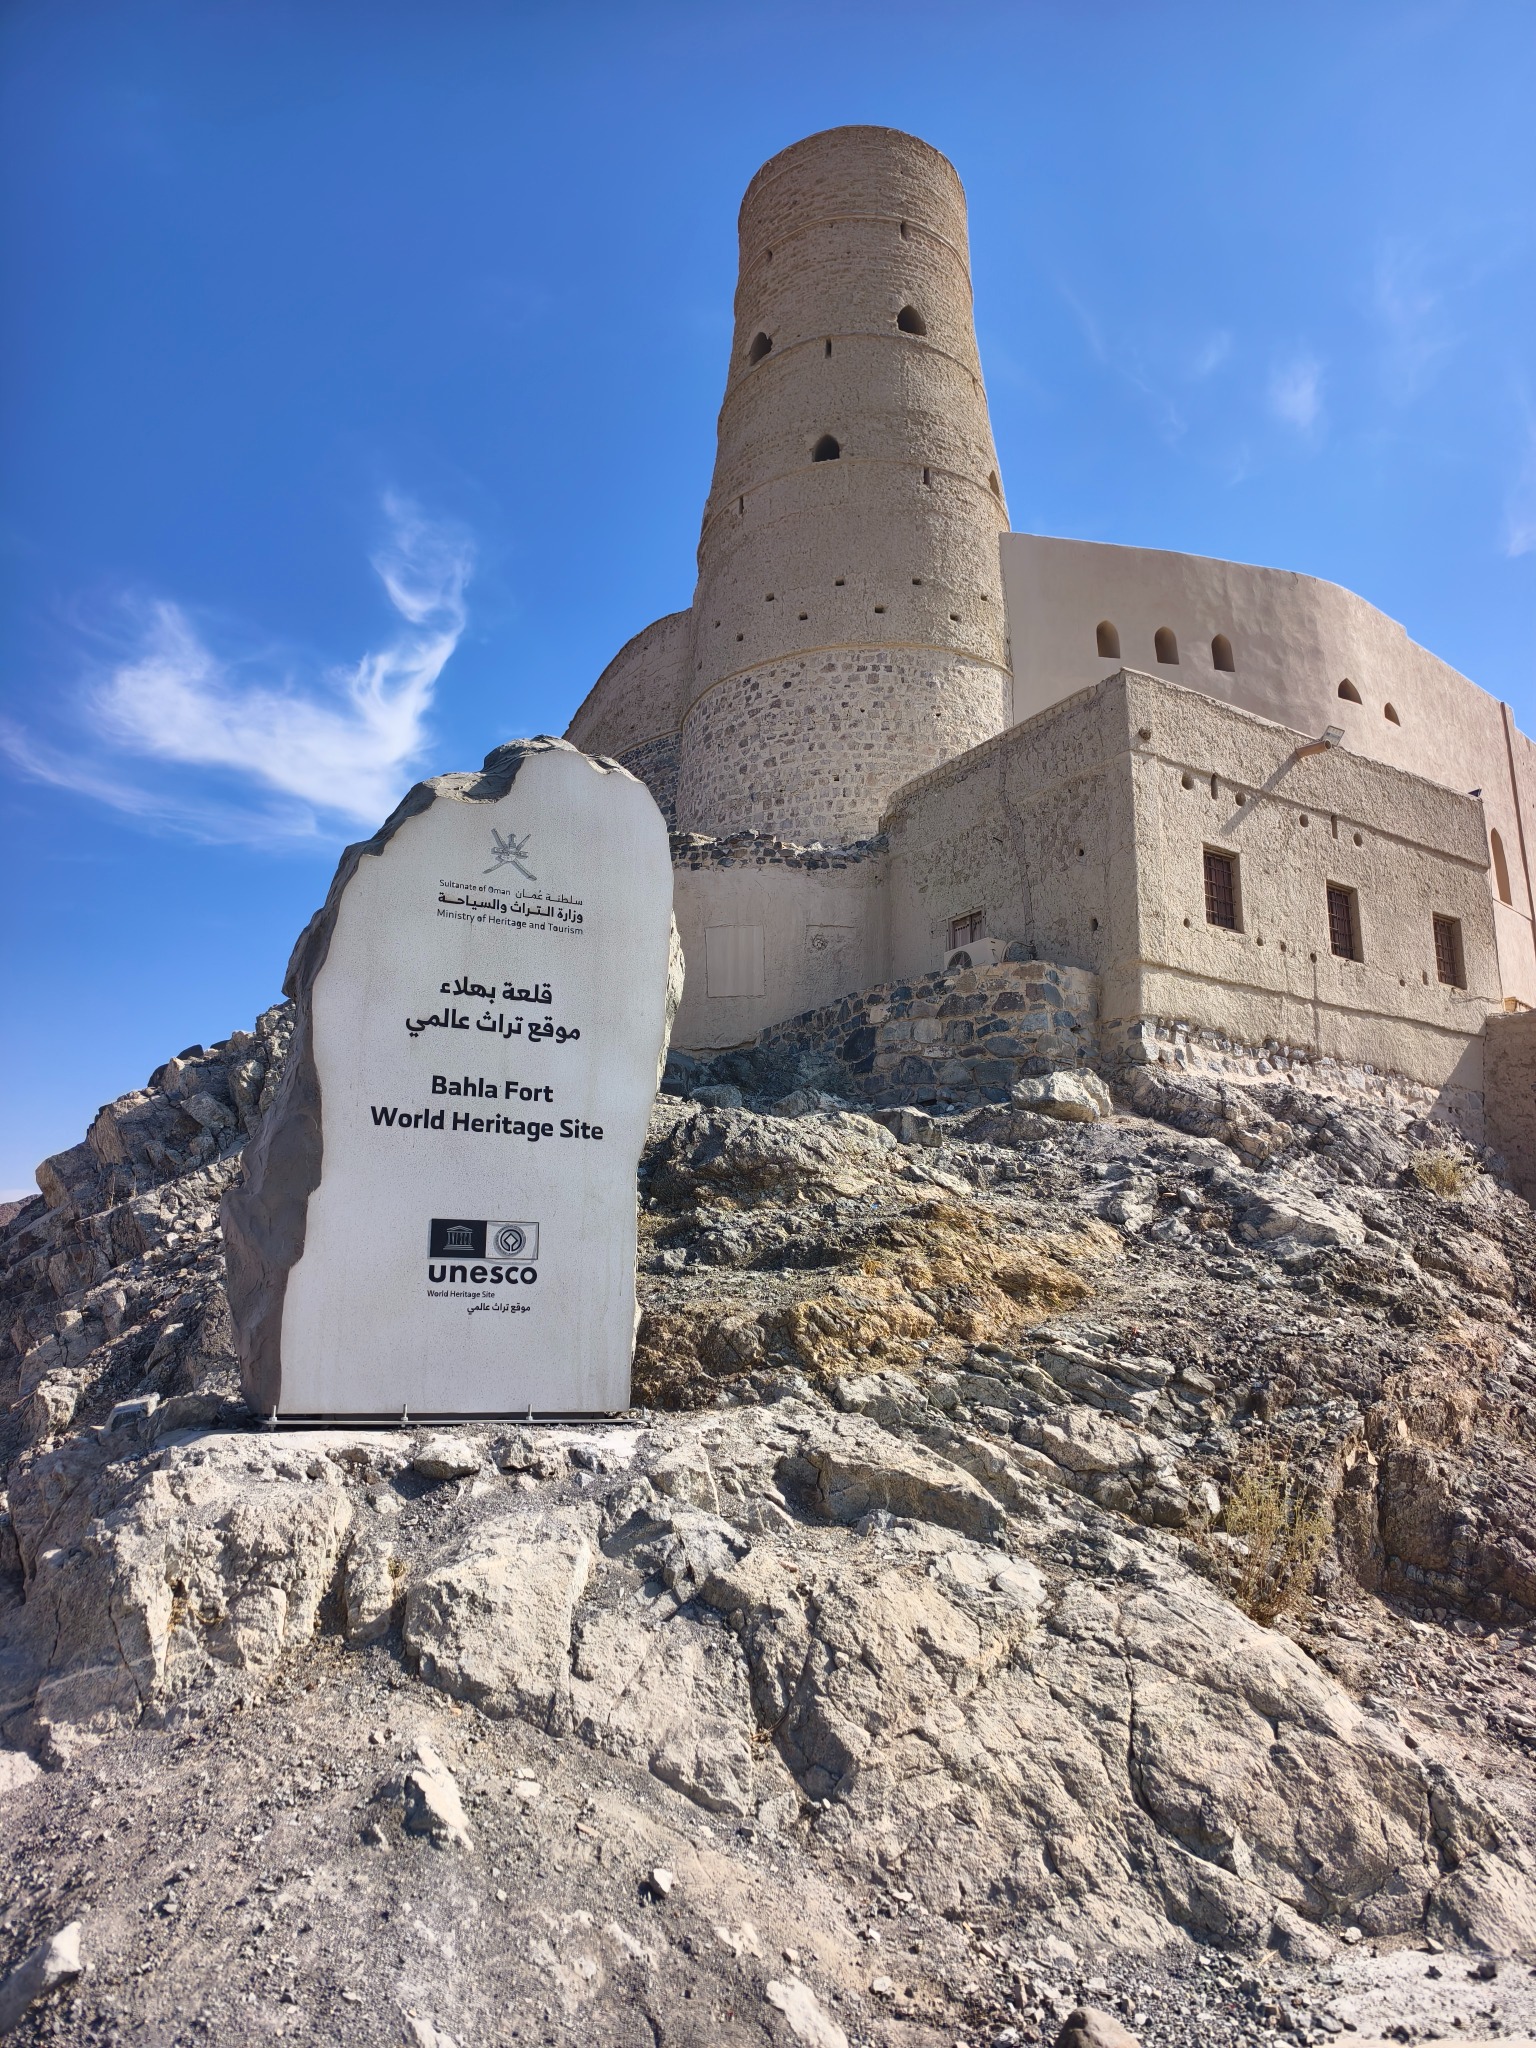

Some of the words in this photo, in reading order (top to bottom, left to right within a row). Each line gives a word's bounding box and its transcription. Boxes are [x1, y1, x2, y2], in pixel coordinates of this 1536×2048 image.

[439, 879, 477, 891] Sultanate
[478, 884, 487, 892] of
[488, 886, 511, 896] Oman
[436, 908, 475, 923] Ministry
[477, 914, 487, 923] of
[488, 915, 527, 929] Heritage
[529, 921, 545, 931] and
[548, 923, 583, 935] Tourism
[557, 907, 583, 924] وزارة
[440, 976, 496, 1004] بهلاء
[502, 981, 552, 1004] قلعة
[405, 1007, 470, 1038] عالمي
[476, 1010, 523, 1039] تراث
[527, 1015, 581, 1043] موقع
[431, 1075, 498, 1099] Bahla
[505, 1081, 554, 1103] Fort
[370, 1105, 445, 1130] World
[452, 1111, 554, 1142] Heritage
[559, 1118, 604, 1140] Site
[428, 1264, 538, 1285] unesco
[427, 1289, 449, 1298] World
[450, 1290, 481, 1299] Heritage
[482, 1290, 496, 1298] Site
[467, 1302, 490, 1315] عالمي
[492, 1303, 509, 1313] تراث
[510, 1302, 531, 1313] موقع
